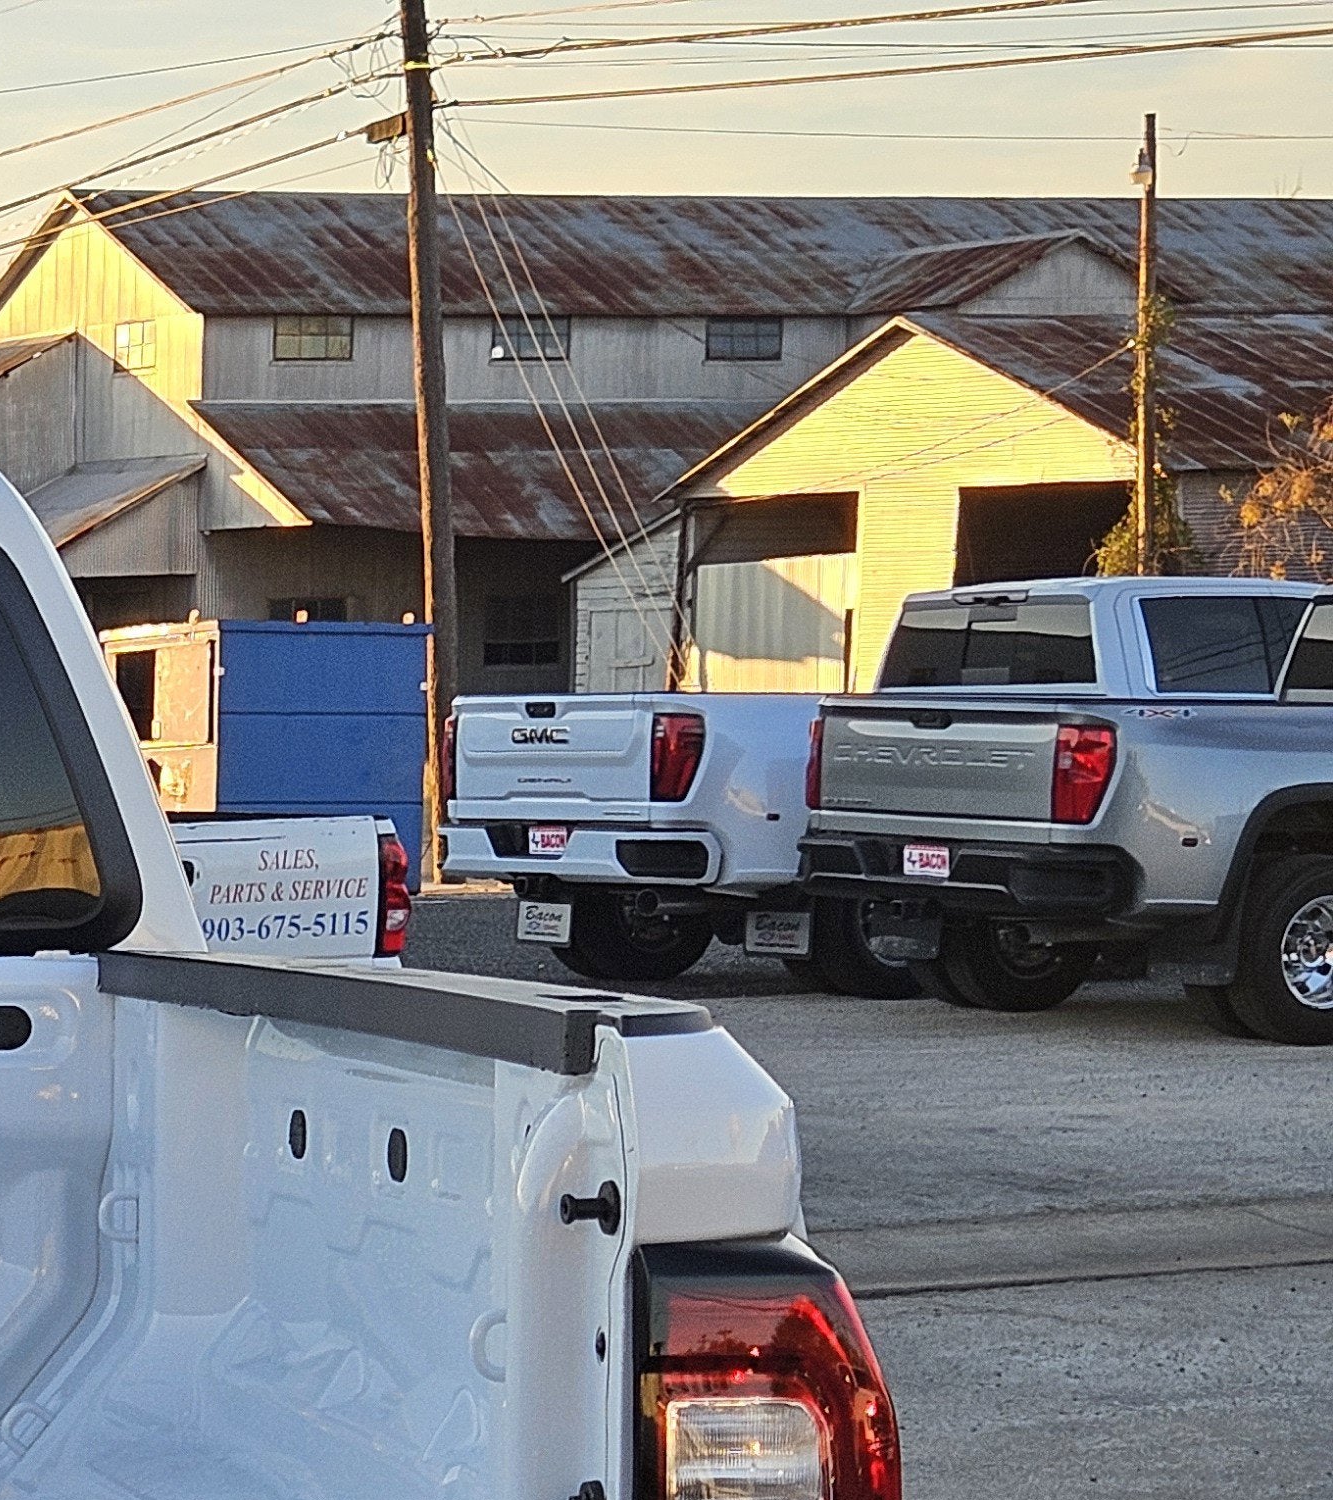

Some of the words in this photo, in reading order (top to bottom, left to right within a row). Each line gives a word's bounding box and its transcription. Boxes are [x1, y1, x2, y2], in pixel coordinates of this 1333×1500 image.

[511, 727, 569, 744] GMC
[833, 743, 1036, 770] CHEVROLET
[540, 833, 566, 849] BACON
[258, 849, 320, 872] SALES,
[919, 852, 948, 869] BACON
[209, 882, 267, 904] PARTS
[270, 881, 284, 902] &
[288, 877, 369, 901] SERVICE
[526, 905, 563, 922] Bacon
[201, 910, 369, 942] 903-675-5115
